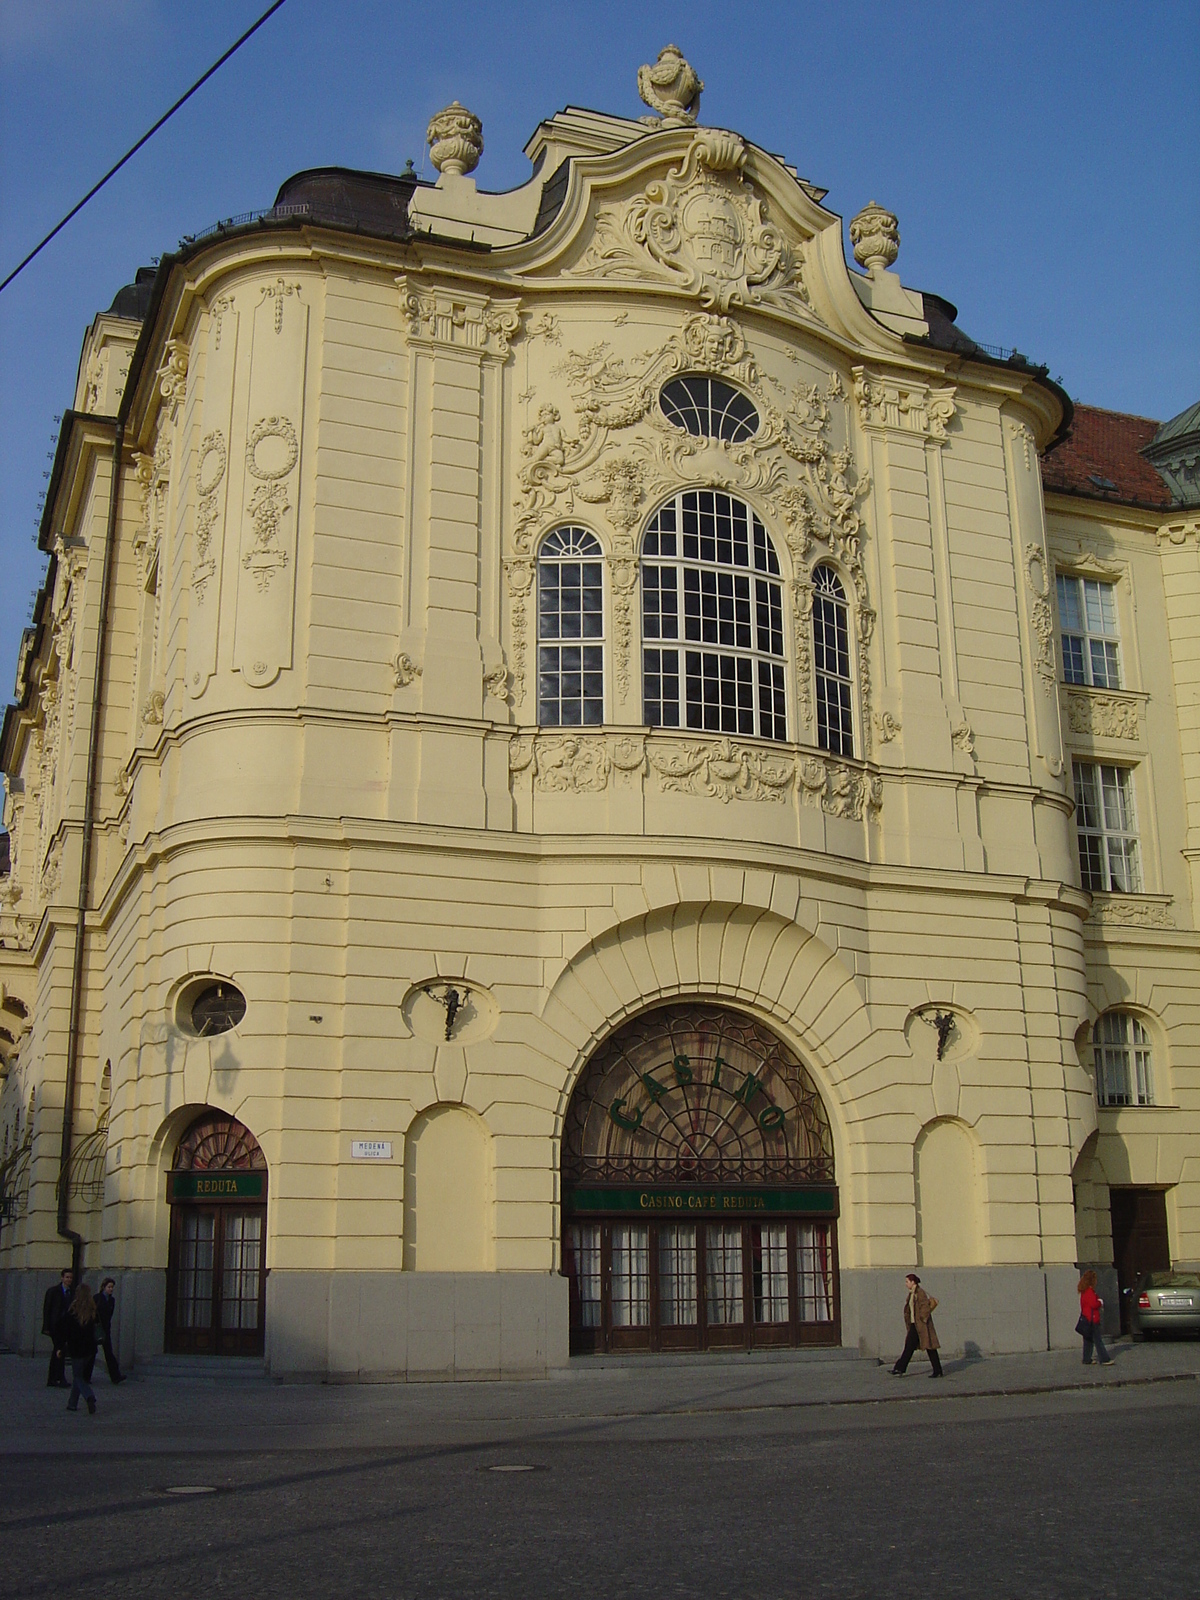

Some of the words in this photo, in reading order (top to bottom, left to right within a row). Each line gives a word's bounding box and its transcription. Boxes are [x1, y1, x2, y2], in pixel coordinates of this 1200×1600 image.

[610, 1054, 786, 1132] CASINO
[197, 1180, 238, 1193] REDUTA
[723, 1196, 765, 1208] REDUTA
